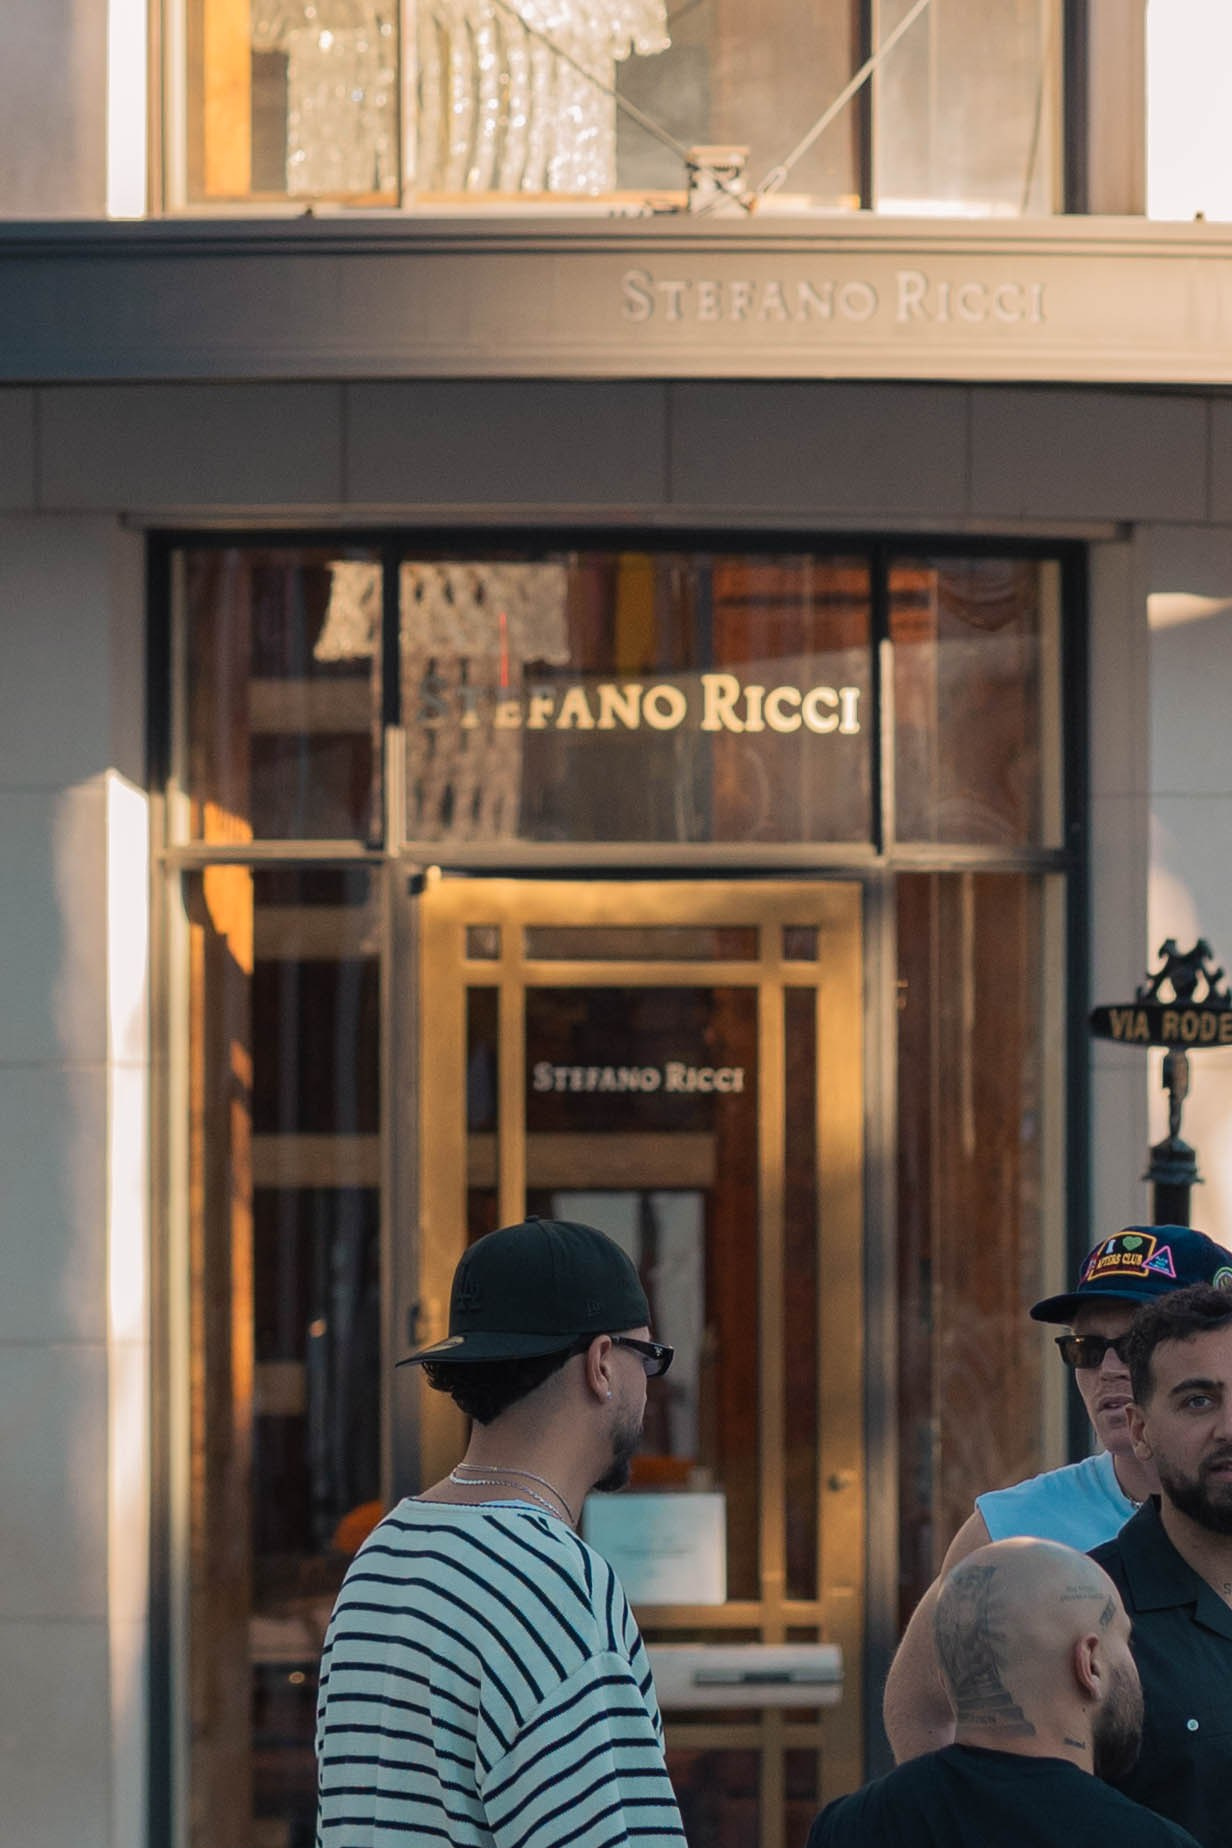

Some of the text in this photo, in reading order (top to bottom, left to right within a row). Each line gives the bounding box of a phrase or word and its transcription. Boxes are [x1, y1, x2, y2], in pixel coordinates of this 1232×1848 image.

[621, 268, 1047, 324] STEFANO RICCI
[701, 673, 860, 734] RICCI
[1109, 1009, 1150, 1042] VIA
[533, 1061, 745, 1092] STEFANO RICCI
